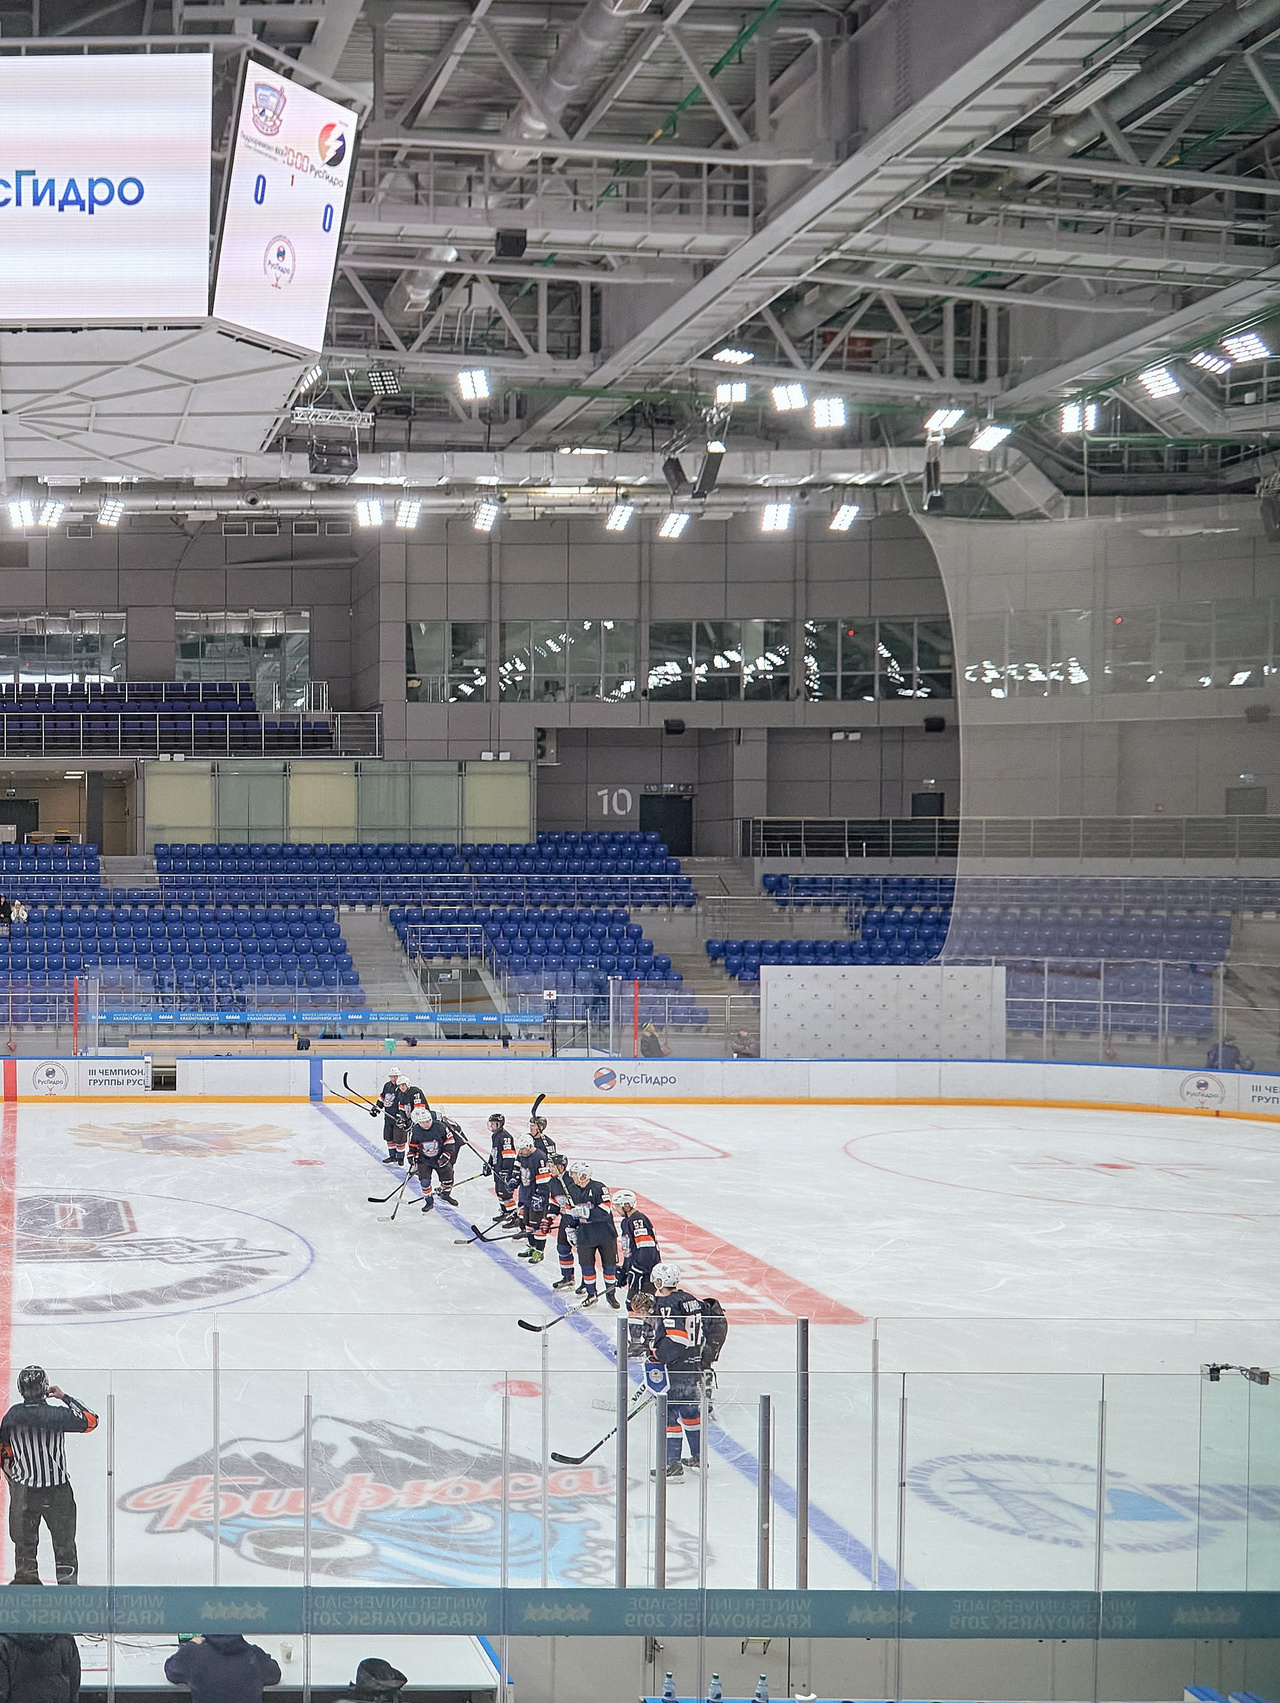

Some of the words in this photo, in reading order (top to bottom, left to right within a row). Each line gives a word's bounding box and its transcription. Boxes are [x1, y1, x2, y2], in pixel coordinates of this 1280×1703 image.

[309, 164, 344, 188] РусГидро
[254, 174, 267, 205] 0
[322, 203, 334, 233] 0
[597, 788, 632, 816] 10
[88, 1069, 97, 1077] III
[37, 1078, 64, 1086] РусГидро
[88, 1079, 123, 1087] ГРУППЫ
[619, 1074, 677, 1086] РусГидро
[1186, 1091, 1219, 1099] РусГидро
[632, 1219, 644, 1229] 53
[97, 1244, 191, 1256] 2023
[124, 1467, 628, 1531] Бирюса
